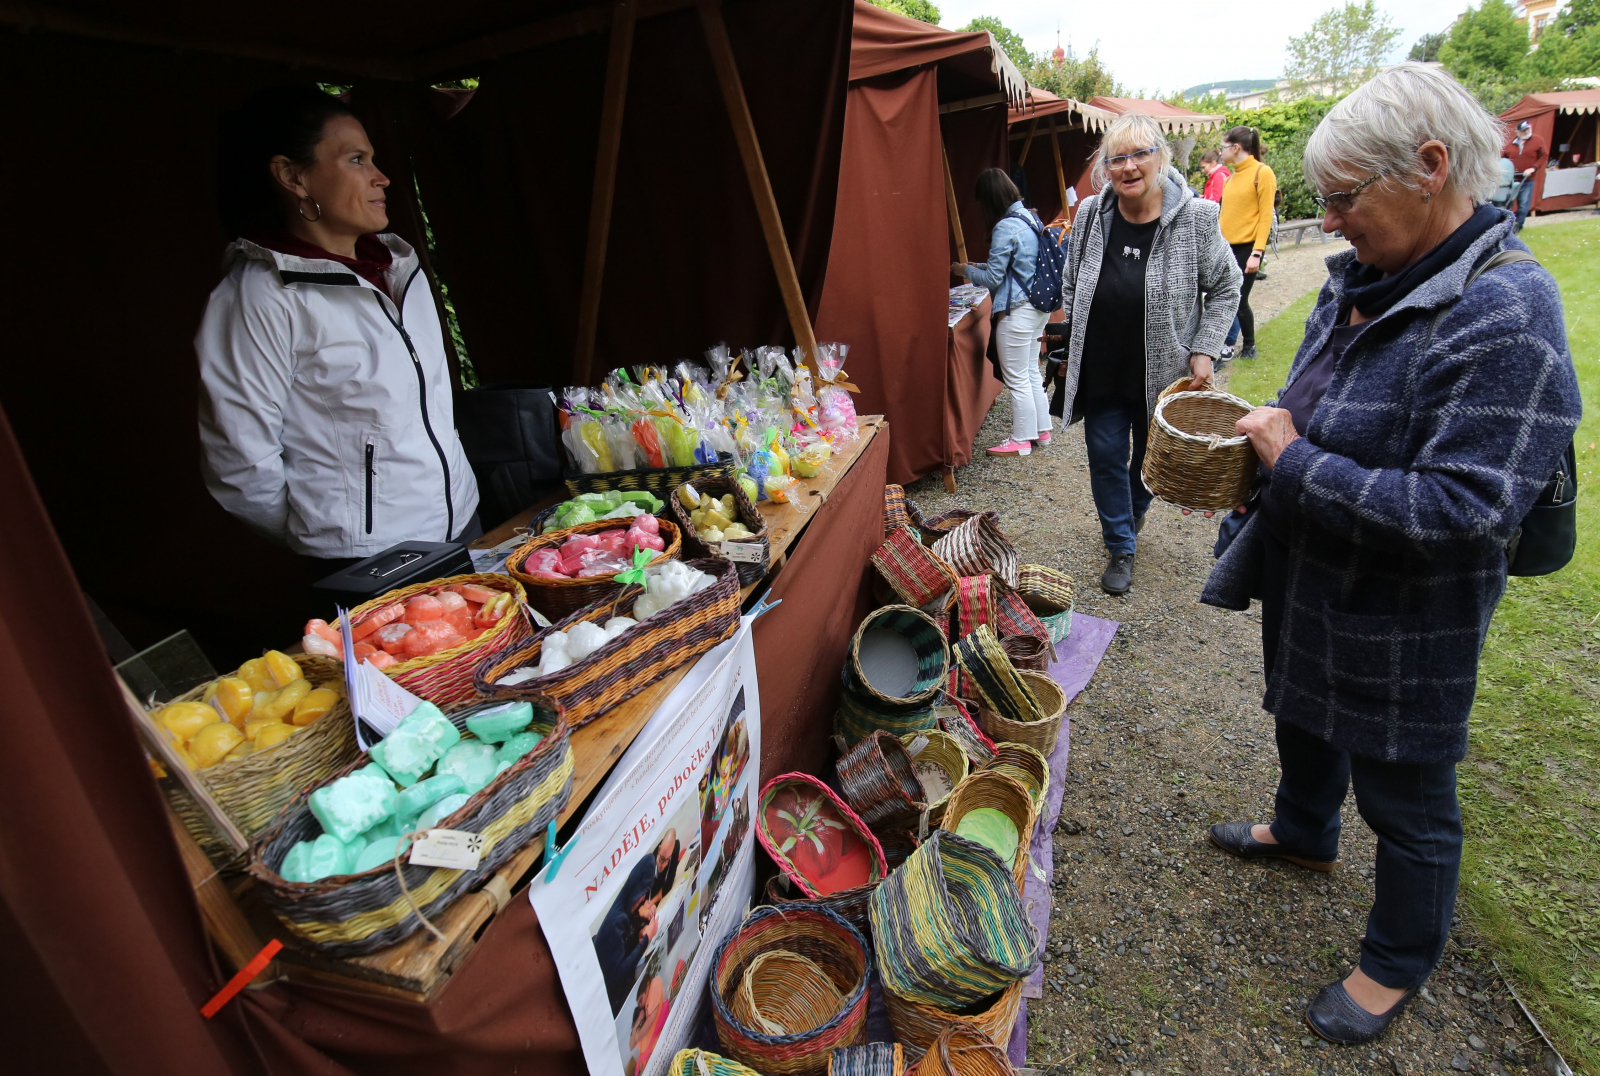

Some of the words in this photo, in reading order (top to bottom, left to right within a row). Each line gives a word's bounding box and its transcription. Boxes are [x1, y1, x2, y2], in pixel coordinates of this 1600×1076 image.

[635, 745, 668, 785] handicapem
[671, 716, 690, 740] osobám
[582, 787, 624, 835] Poskytujeme
[624, 761, 644, 789] pomoc
[584, 812, 656, 904] NADĚJE,
[658, 740, 710, 817] pobočka
